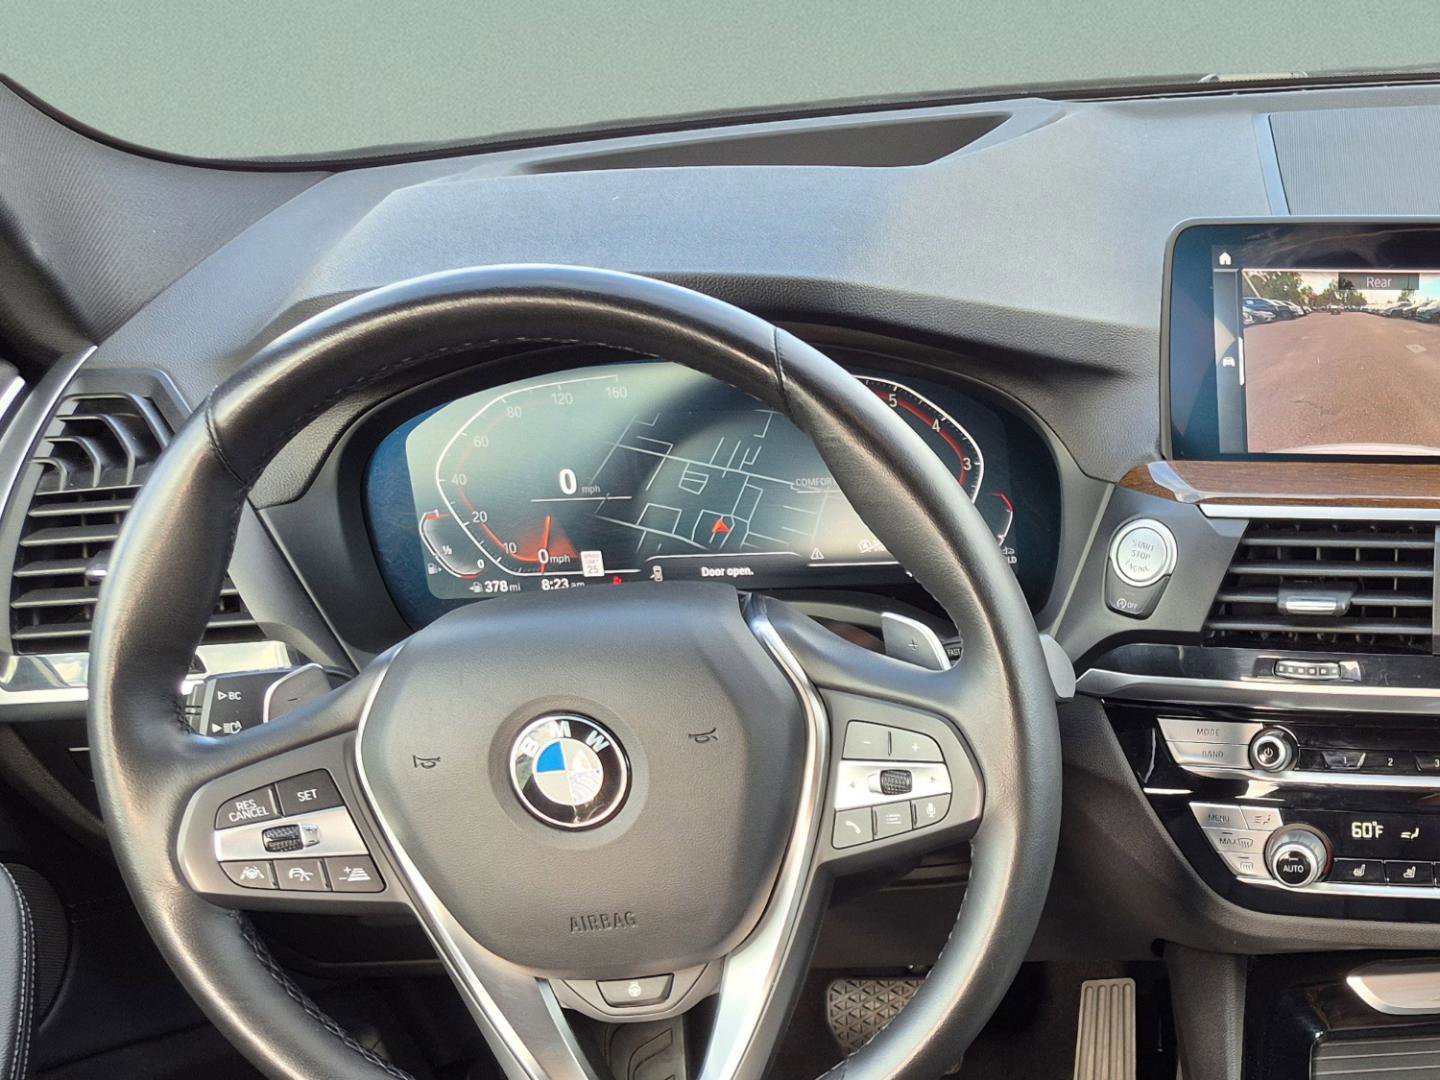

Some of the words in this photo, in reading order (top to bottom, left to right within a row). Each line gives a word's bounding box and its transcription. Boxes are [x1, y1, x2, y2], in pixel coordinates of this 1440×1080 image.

[1366, 276, 1392, 288] Rear
[551, 392, 574, 405] 120
[606, 386, 629, 399] 160
[888, 394, 898, 408] 5
[506, 405, 522, 418] 80
[932, 419, 941, 432] 4
[473, 436, 490, 449] 60
[962, 456, 972, 471] 3
[451, 474, 467, 486] 40
[558, 468, 577, 495] 0
[581, 483, 601, 493] mph
[471, 510, 488, 524] 20
[503, 541, 518, 555] 10
[537, 548, 550, 565] 0
[550, 555, 571, 564] mph
[701, 566, 725, 578] Door
[726, 566, 755, 580] open.
[484, 580, 509, 593] 378
[509, 580, 521, 592] mi
[541, 578, 569, 590] 8:23
[228, 691, 242, 701] BC
[519, 719, 610, 758] BMW
[1343, 757, 1348, 765] 1
[1387, 757, 1394, 766] 2
[1434, 759, 1440, 768] 3
[296, 788, 318, 802] SET
[236, 799, 257, 810] RES
[228, 806, 270, 822] CANCEL
[1282, 865, 1305, 874] AUTO
[568, 911, 637, 934] AIRBAG
